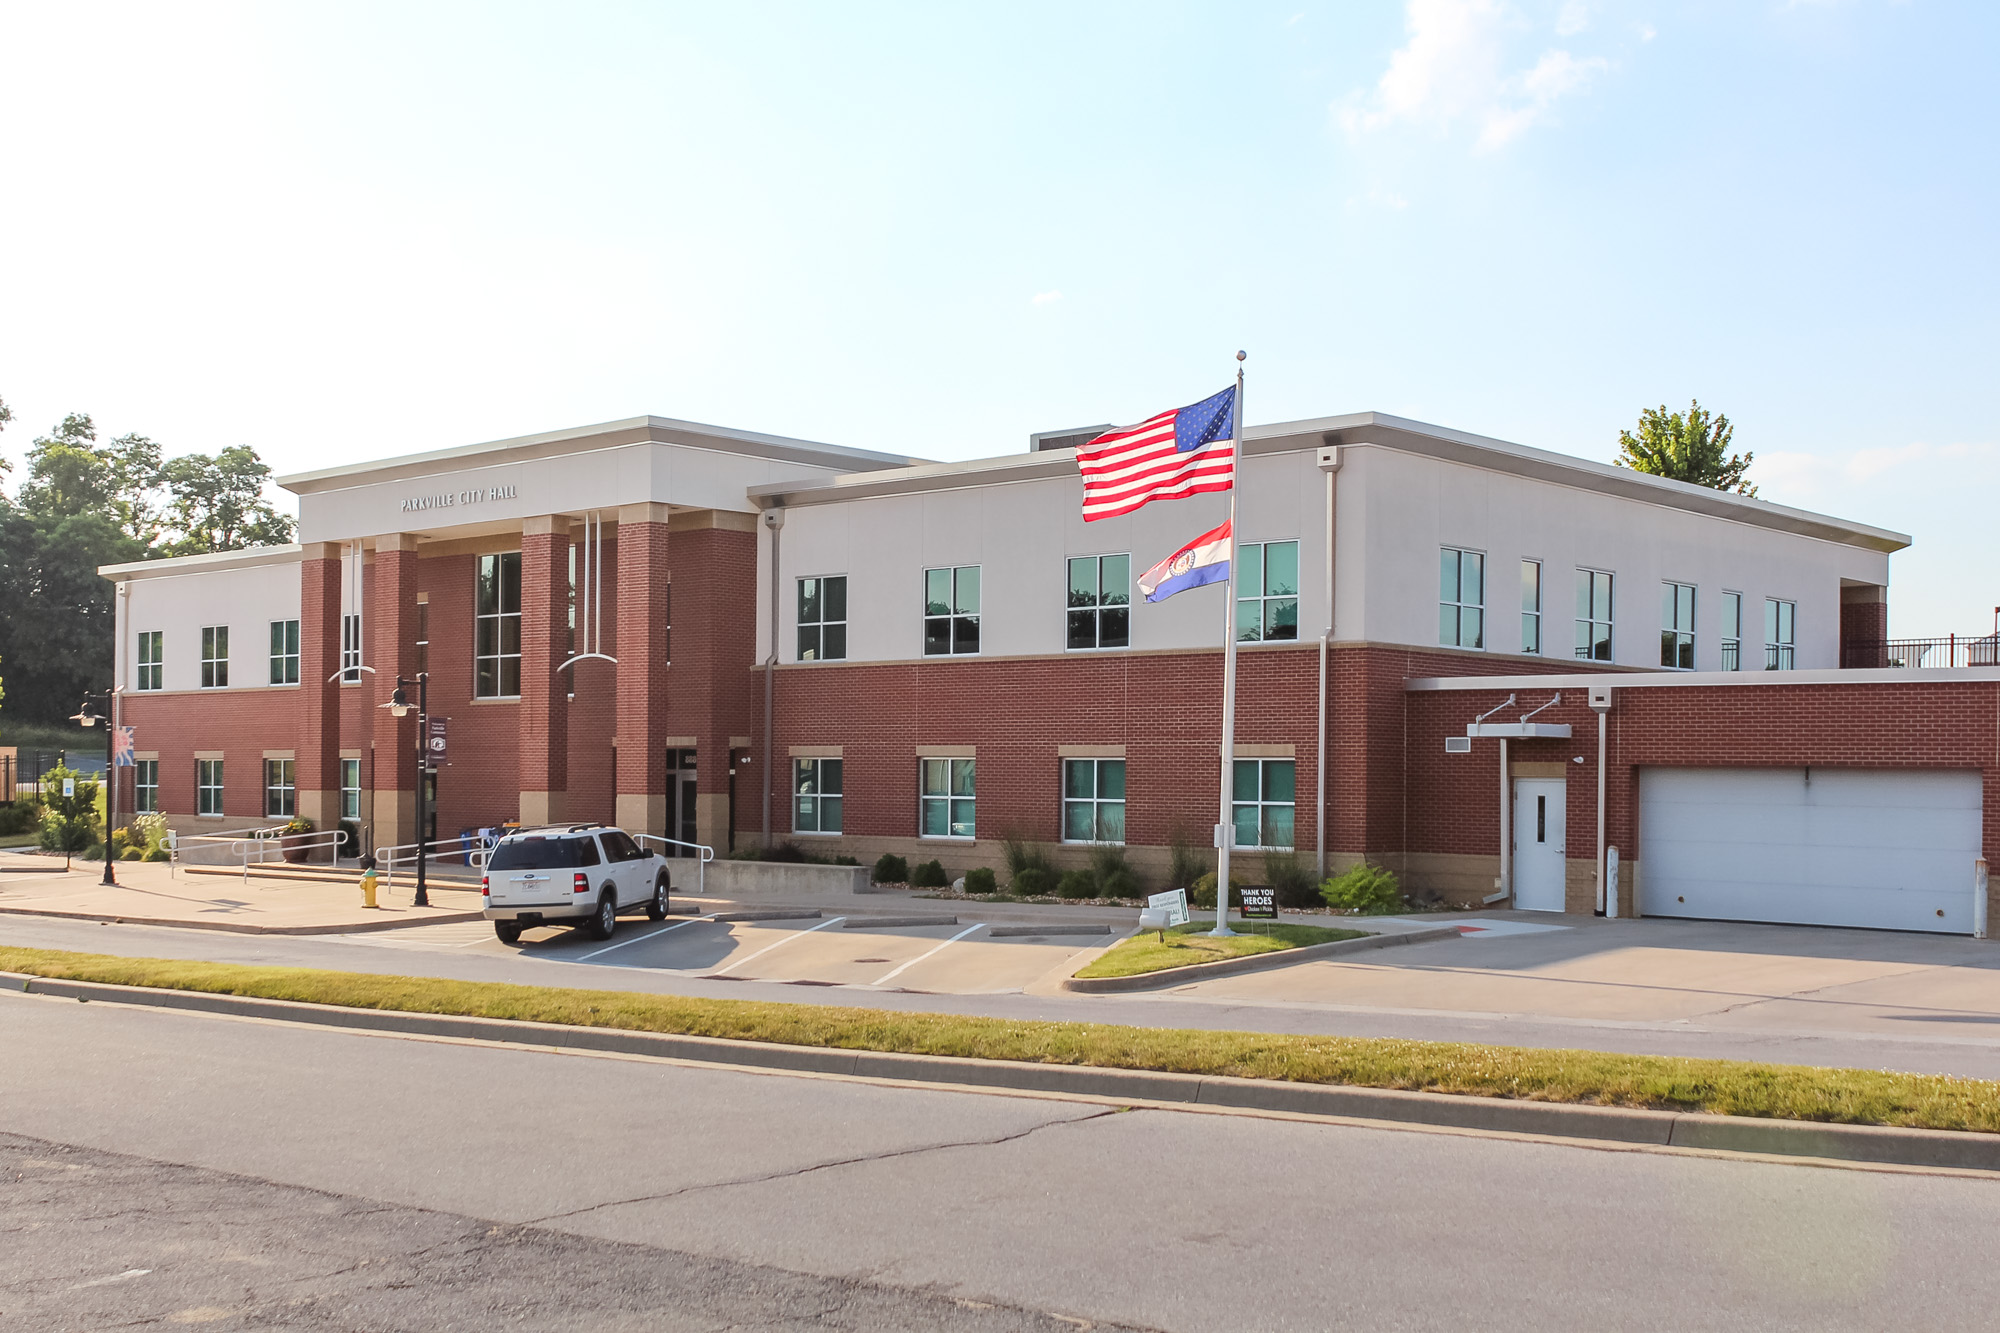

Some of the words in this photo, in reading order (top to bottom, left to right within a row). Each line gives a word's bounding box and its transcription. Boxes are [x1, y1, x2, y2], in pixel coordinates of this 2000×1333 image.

[401, 493, 454, 512] PARKVILLE
[458, 489, 484, 505] CITY
[489, 485, 517, 500] HALL
[1244, 896, 1272, 905] HEROES
